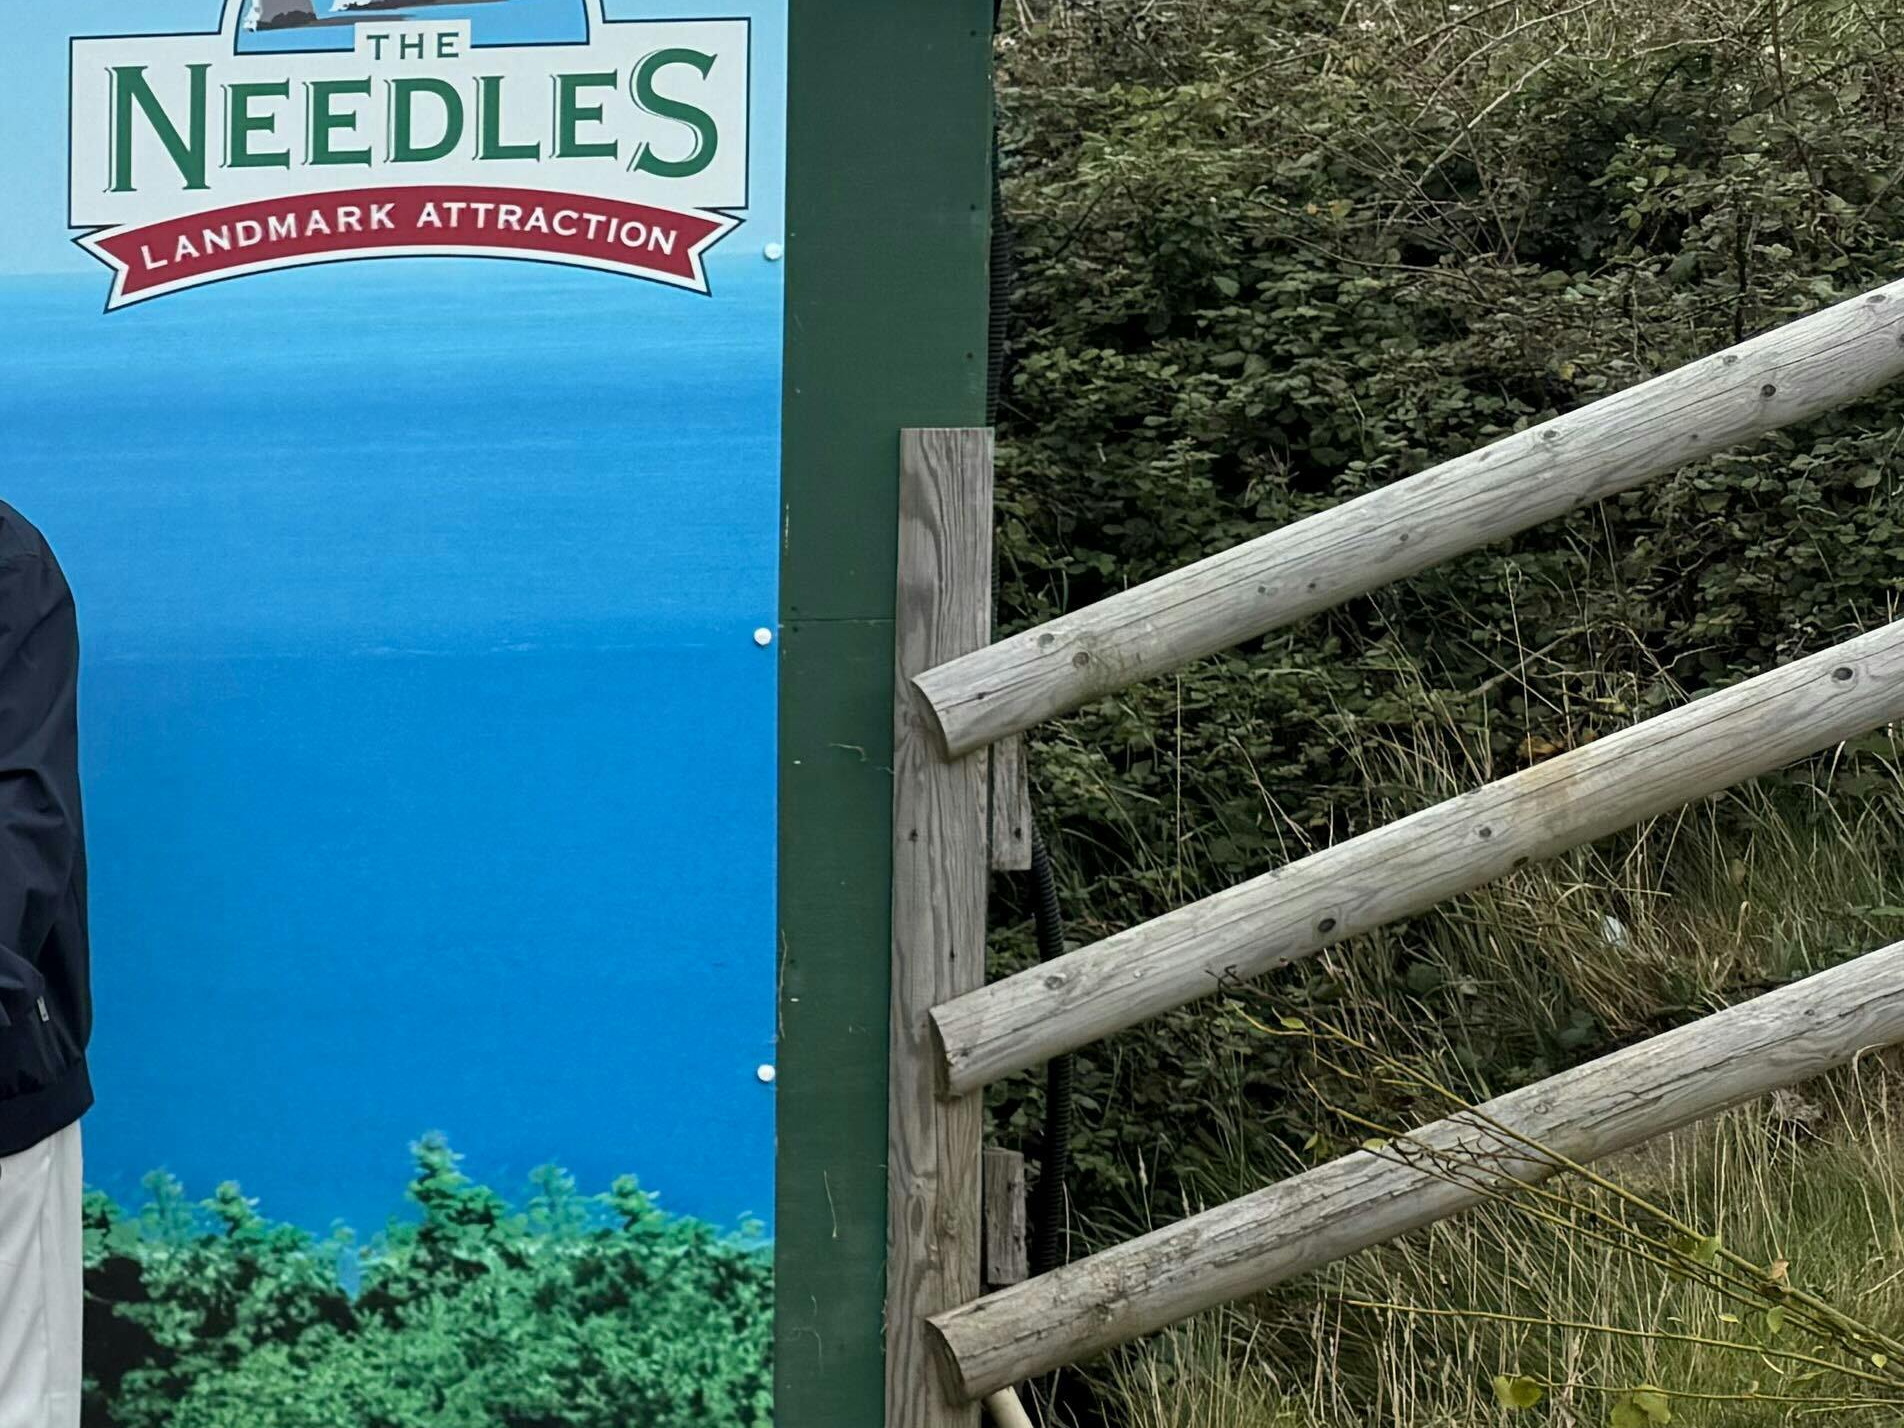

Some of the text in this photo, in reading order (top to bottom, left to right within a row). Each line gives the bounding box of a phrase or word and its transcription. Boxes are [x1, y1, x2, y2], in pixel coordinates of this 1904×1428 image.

[366, 30, 461, 61] THE
[103, 47, 720, 194] NEEDLES
[140, 201, 679, 270] LANDMARK ATTRACTION
